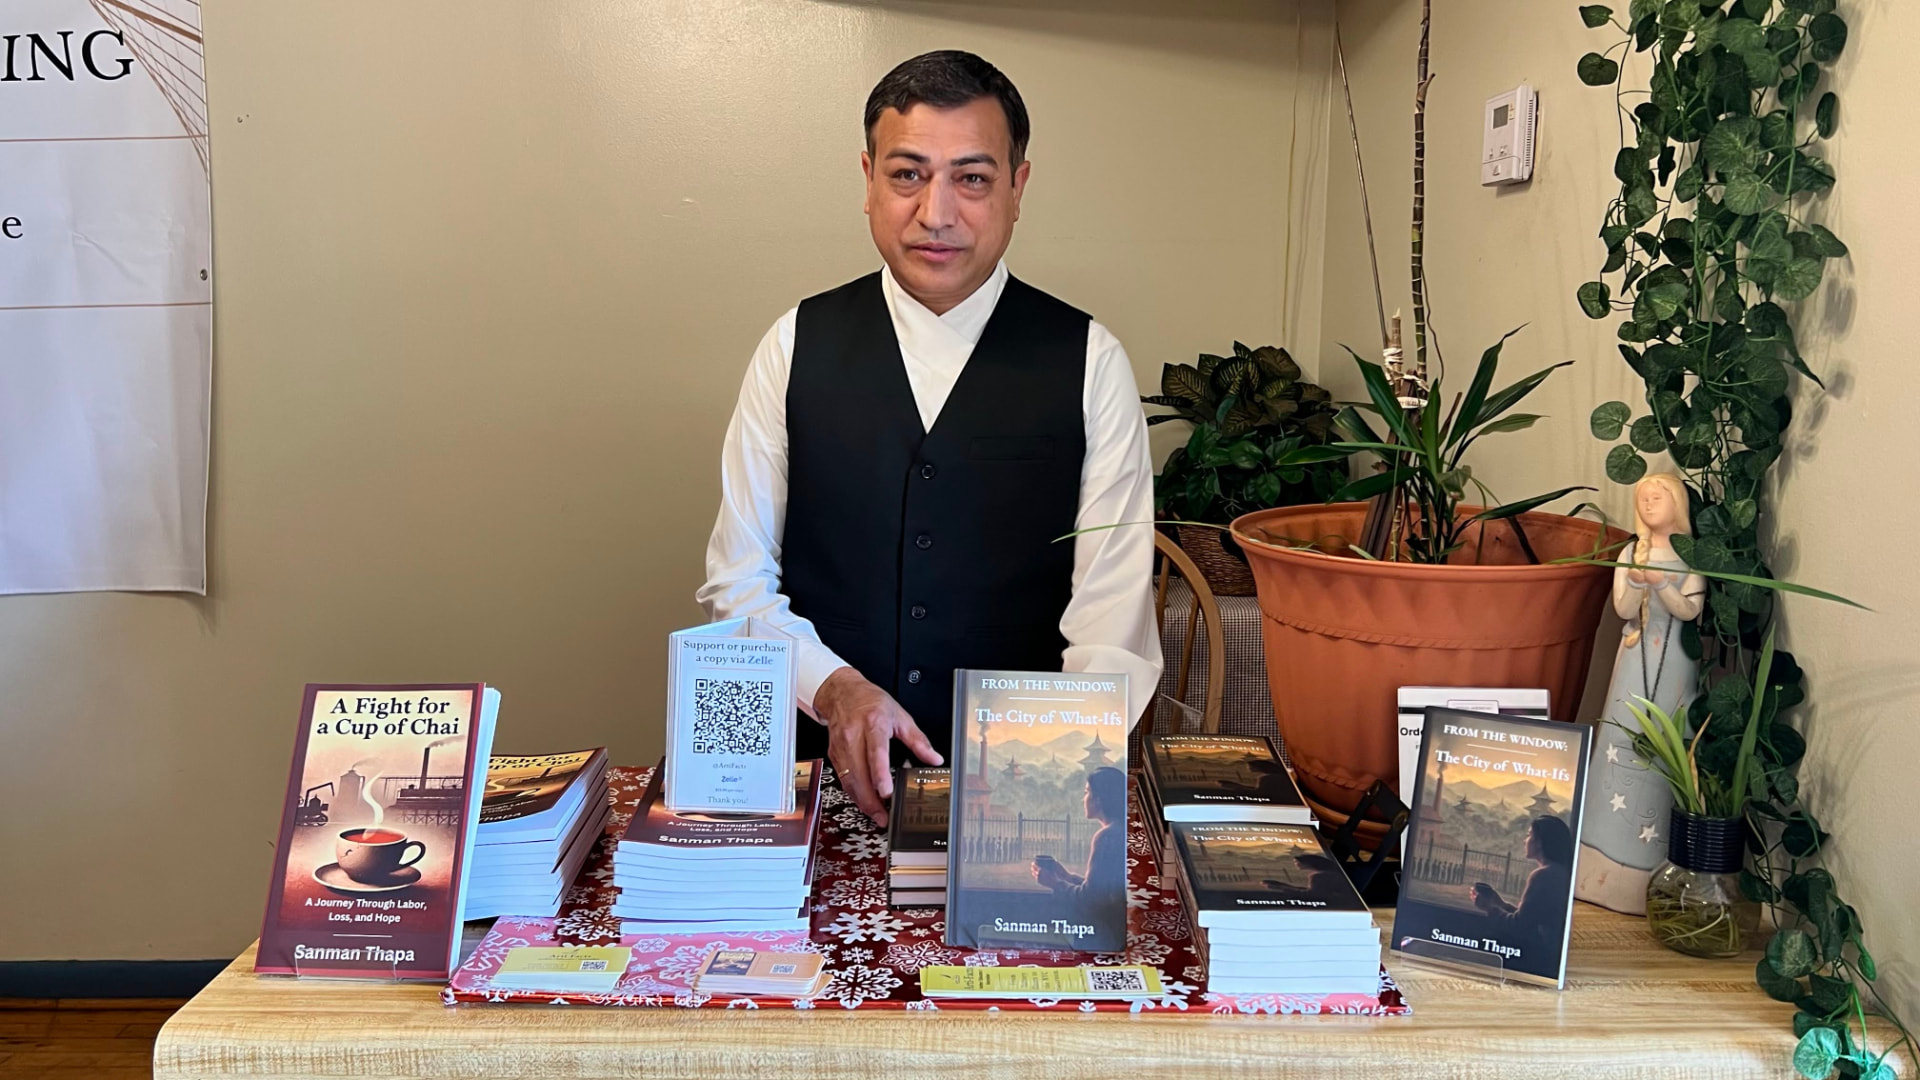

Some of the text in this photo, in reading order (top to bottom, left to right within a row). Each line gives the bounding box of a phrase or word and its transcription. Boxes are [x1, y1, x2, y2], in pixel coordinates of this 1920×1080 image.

[0, 30, 134, 81] ING
[683, 640, 724, 651] Support
[741, 643, 786, 653] purchase
[704, 656, 728, 665] copy
[731, 654, 745, 664] via
[748, 656, 774, 665] Zelle
[981, 678, 1116, 693] FROM THE WINDOW:
[330, 697, 450, 719] A Fight for
[975, 708, 1122, 727] The City of What-Ifs
[316, 717, 459, 739] a Cup of Chai
[1400, 727, 1422, 736] Ord
[1443, 724, 1568, 752] FROM THE WINDOW:
[1435, 749, 1570, 782] The City of What-Ifs
[658, 835, 773, 845] Sanman Thapa
[1190, 834, 1214, 842] The
[1216, 835, 1242, 843] City
[1259, 836, 1313, 844] What-Ifs
[305, 898, 427, 911] A Journey Through Labor,
[1286, 899, 1327, 907] Thapa
[328, 912, 402, 925] Loss, and Hope
[994, 917, 1095, 939] Sanman Thapa
[1431, 928, 1521, 959] Sanman Thapa
[294, 944, 415, 965] Sanman Thapa
